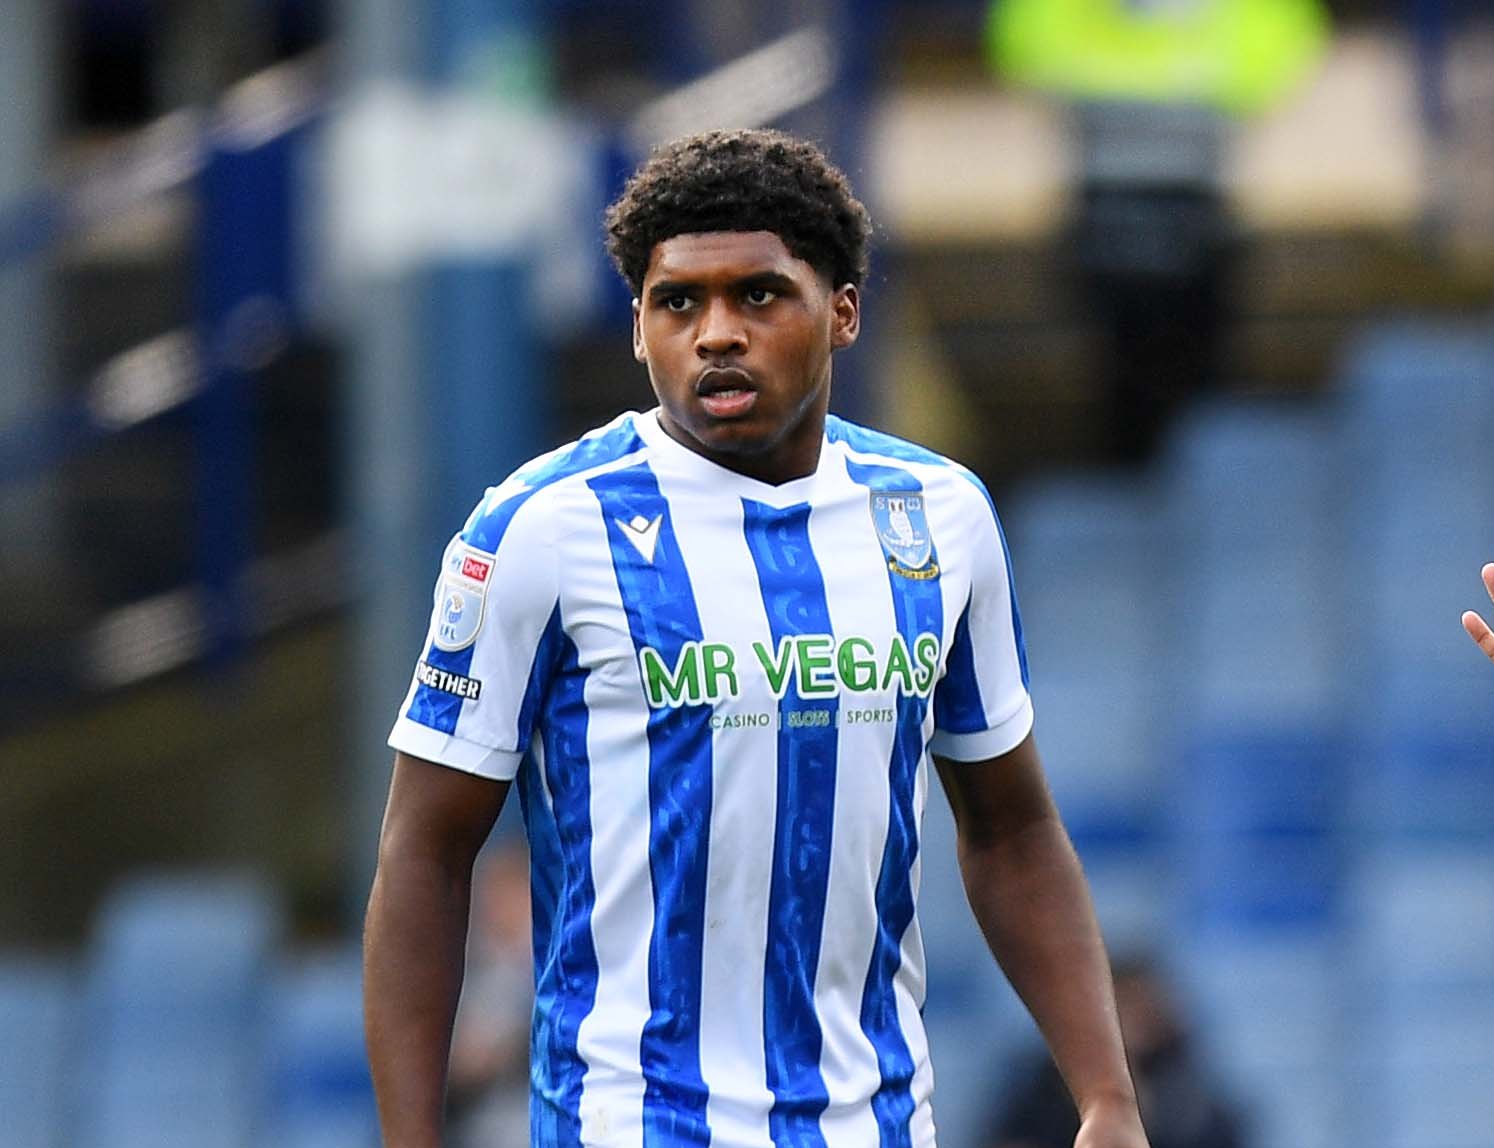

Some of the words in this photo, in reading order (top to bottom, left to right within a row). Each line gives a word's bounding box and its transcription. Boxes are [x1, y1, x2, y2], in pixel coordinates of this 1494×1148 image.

[644, 645, 739, 705] MR
[751, 635, 938, 696] VEGAS
[709, 712, 770, 729] CASINO
[788, 709, 831, 728] SLOTS
[847, 709, 894, 724] SPORTS
